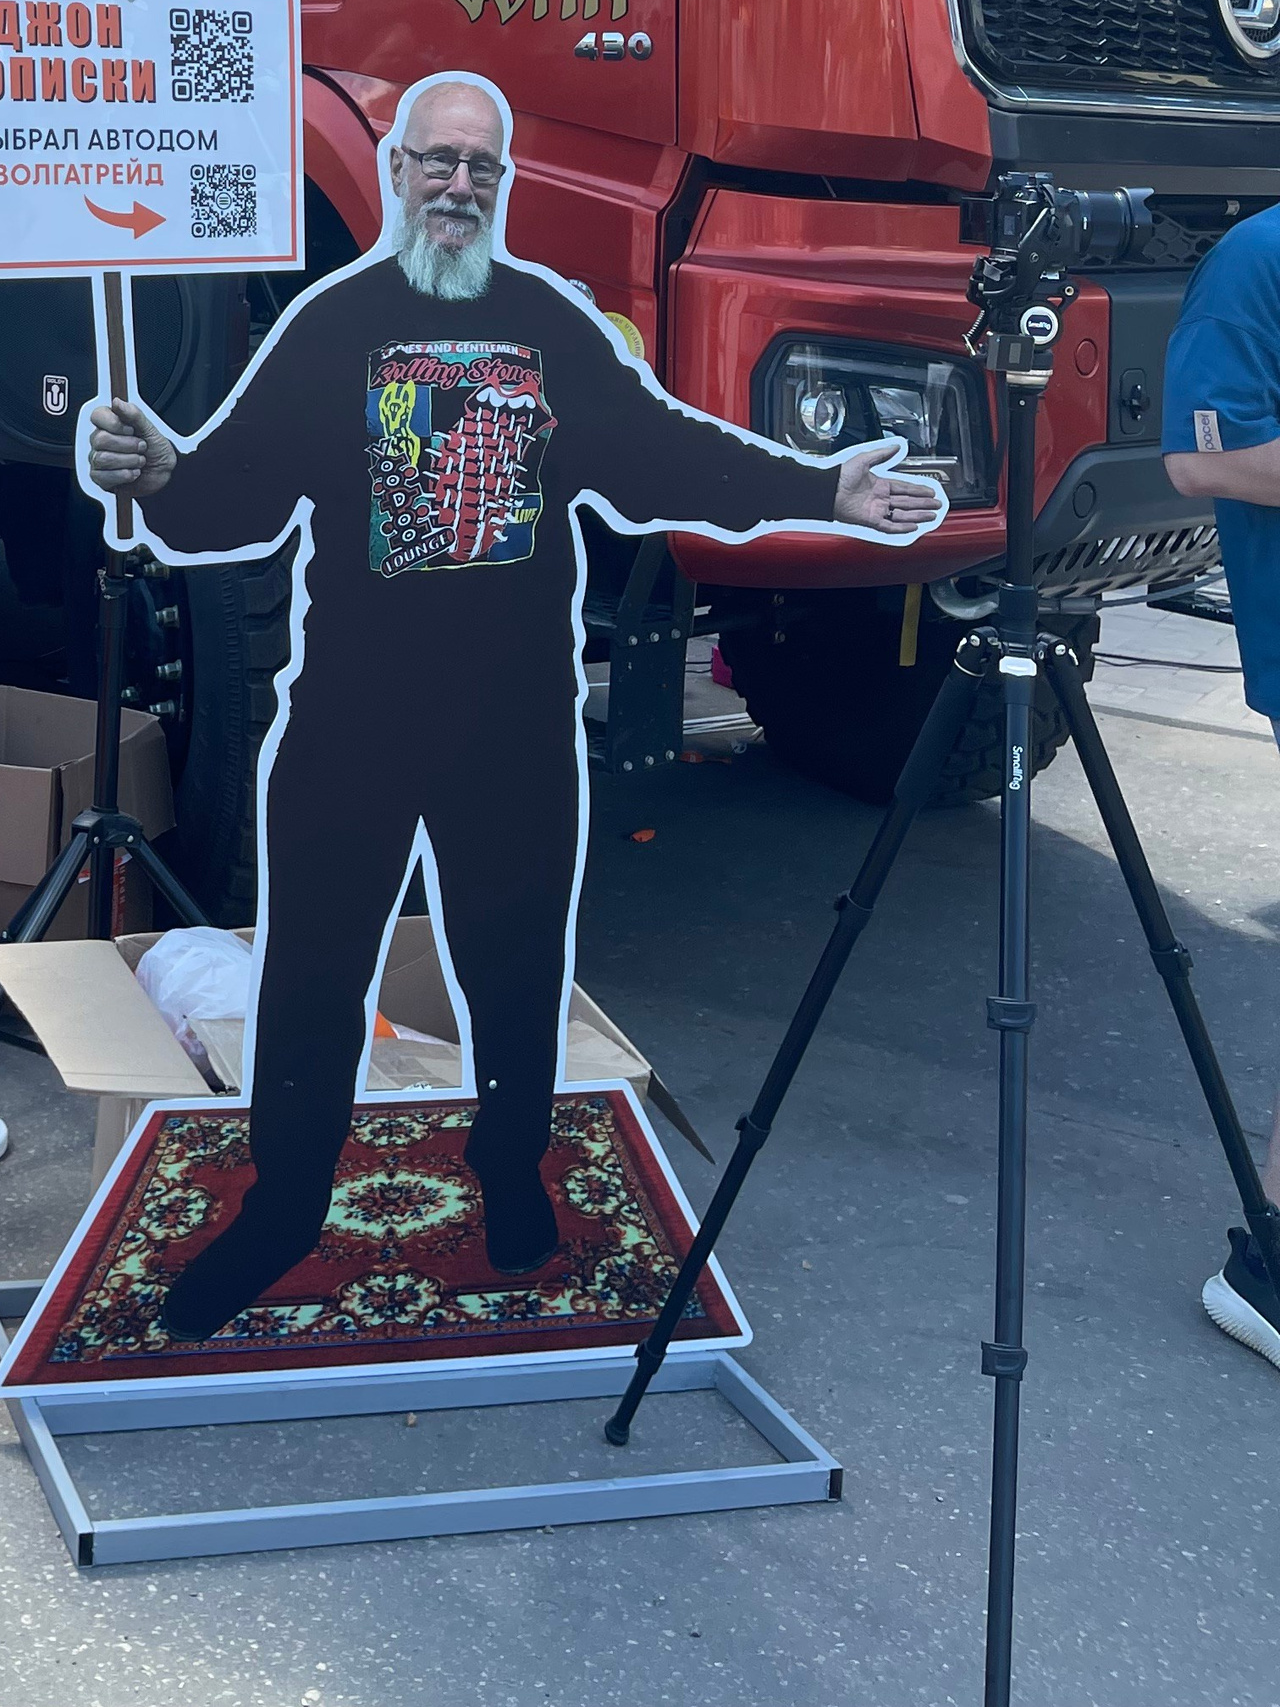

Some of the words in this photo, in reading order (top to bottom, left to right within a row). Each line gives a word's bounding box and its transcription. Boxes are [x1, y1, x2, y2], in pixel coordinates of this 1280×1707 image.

[573, 31, 654, 61] 430
[88, 128, 218, 153] АВТОДОМ
[425, 343, 452, 354] AND
[370, 357, 463, 390] Rolling
[466, 358, 541, 386] Stones
[1200, 413, 1217, 451] pacer
